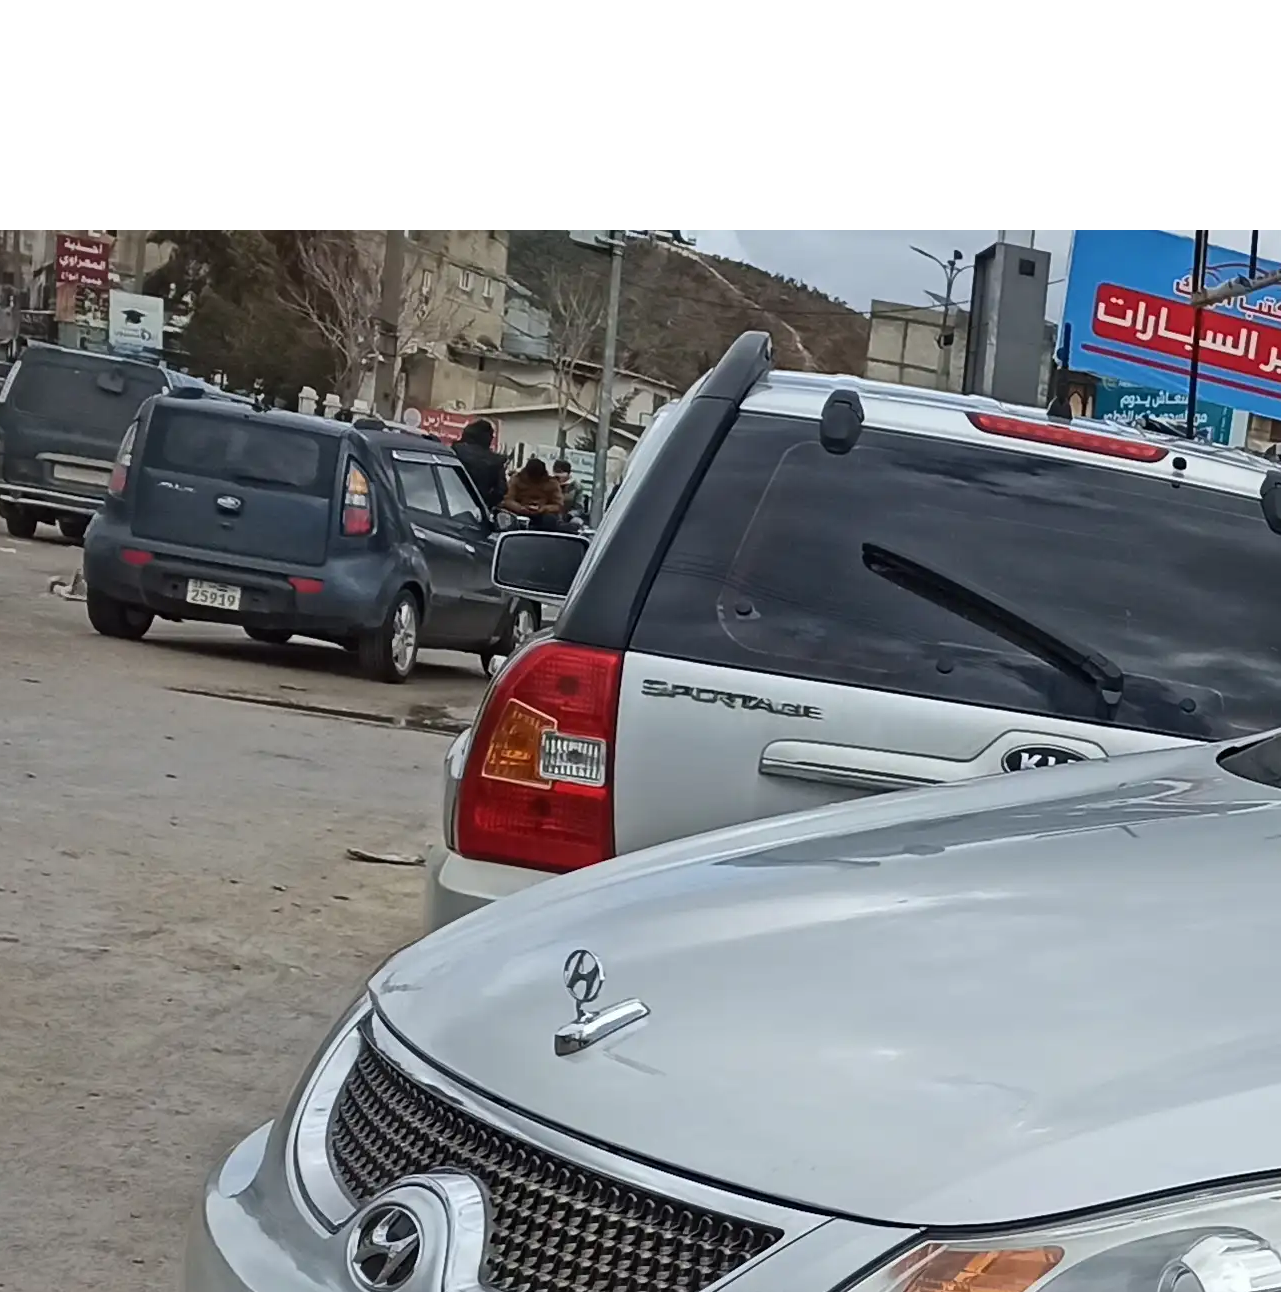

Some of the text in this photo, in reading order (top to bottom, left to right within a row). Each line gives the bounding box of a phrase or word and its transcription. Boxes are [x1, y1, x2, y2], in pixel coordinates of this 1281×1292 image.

[1096, 297, 1259, 360] السيارات
[190, 589, 237, 607] 25919
[641, 679, 825, 720] SPORTAGE
[1020, 752, 1078, 771] KI
